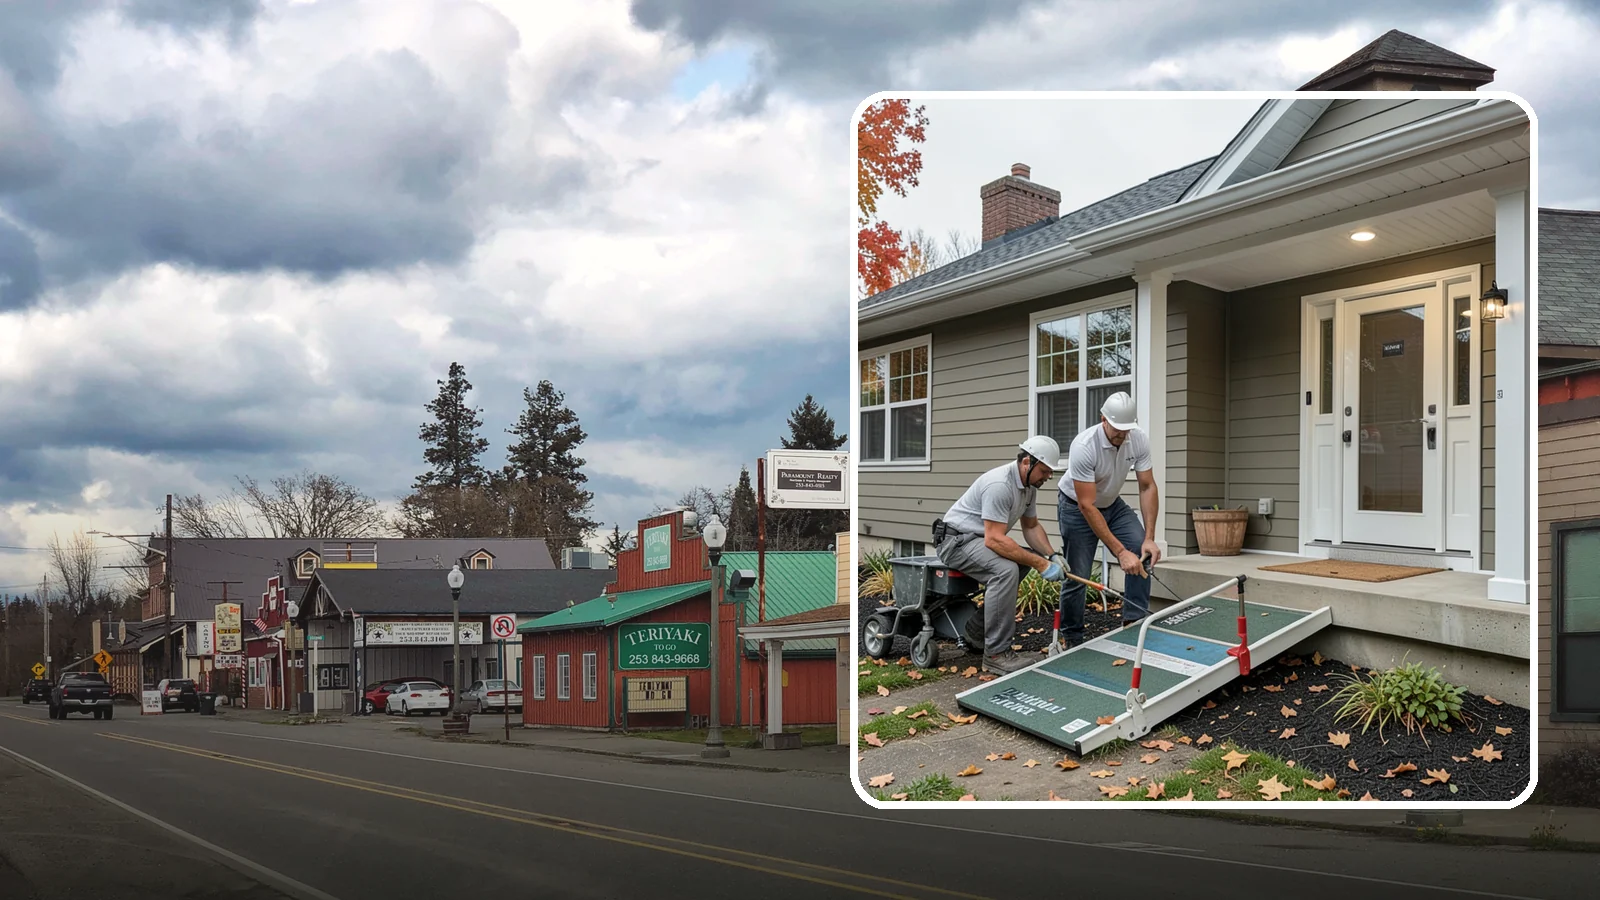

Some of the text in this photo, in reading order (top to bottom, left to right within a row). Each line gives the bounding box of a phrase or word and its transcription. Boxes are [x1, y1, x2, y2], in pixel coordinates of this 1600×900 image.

[625, 627, 702, 646] TERIYAKI
[629, 654, 700, 664] 253 843-9668
[639, 681, 672, 690] TERIYAKI
